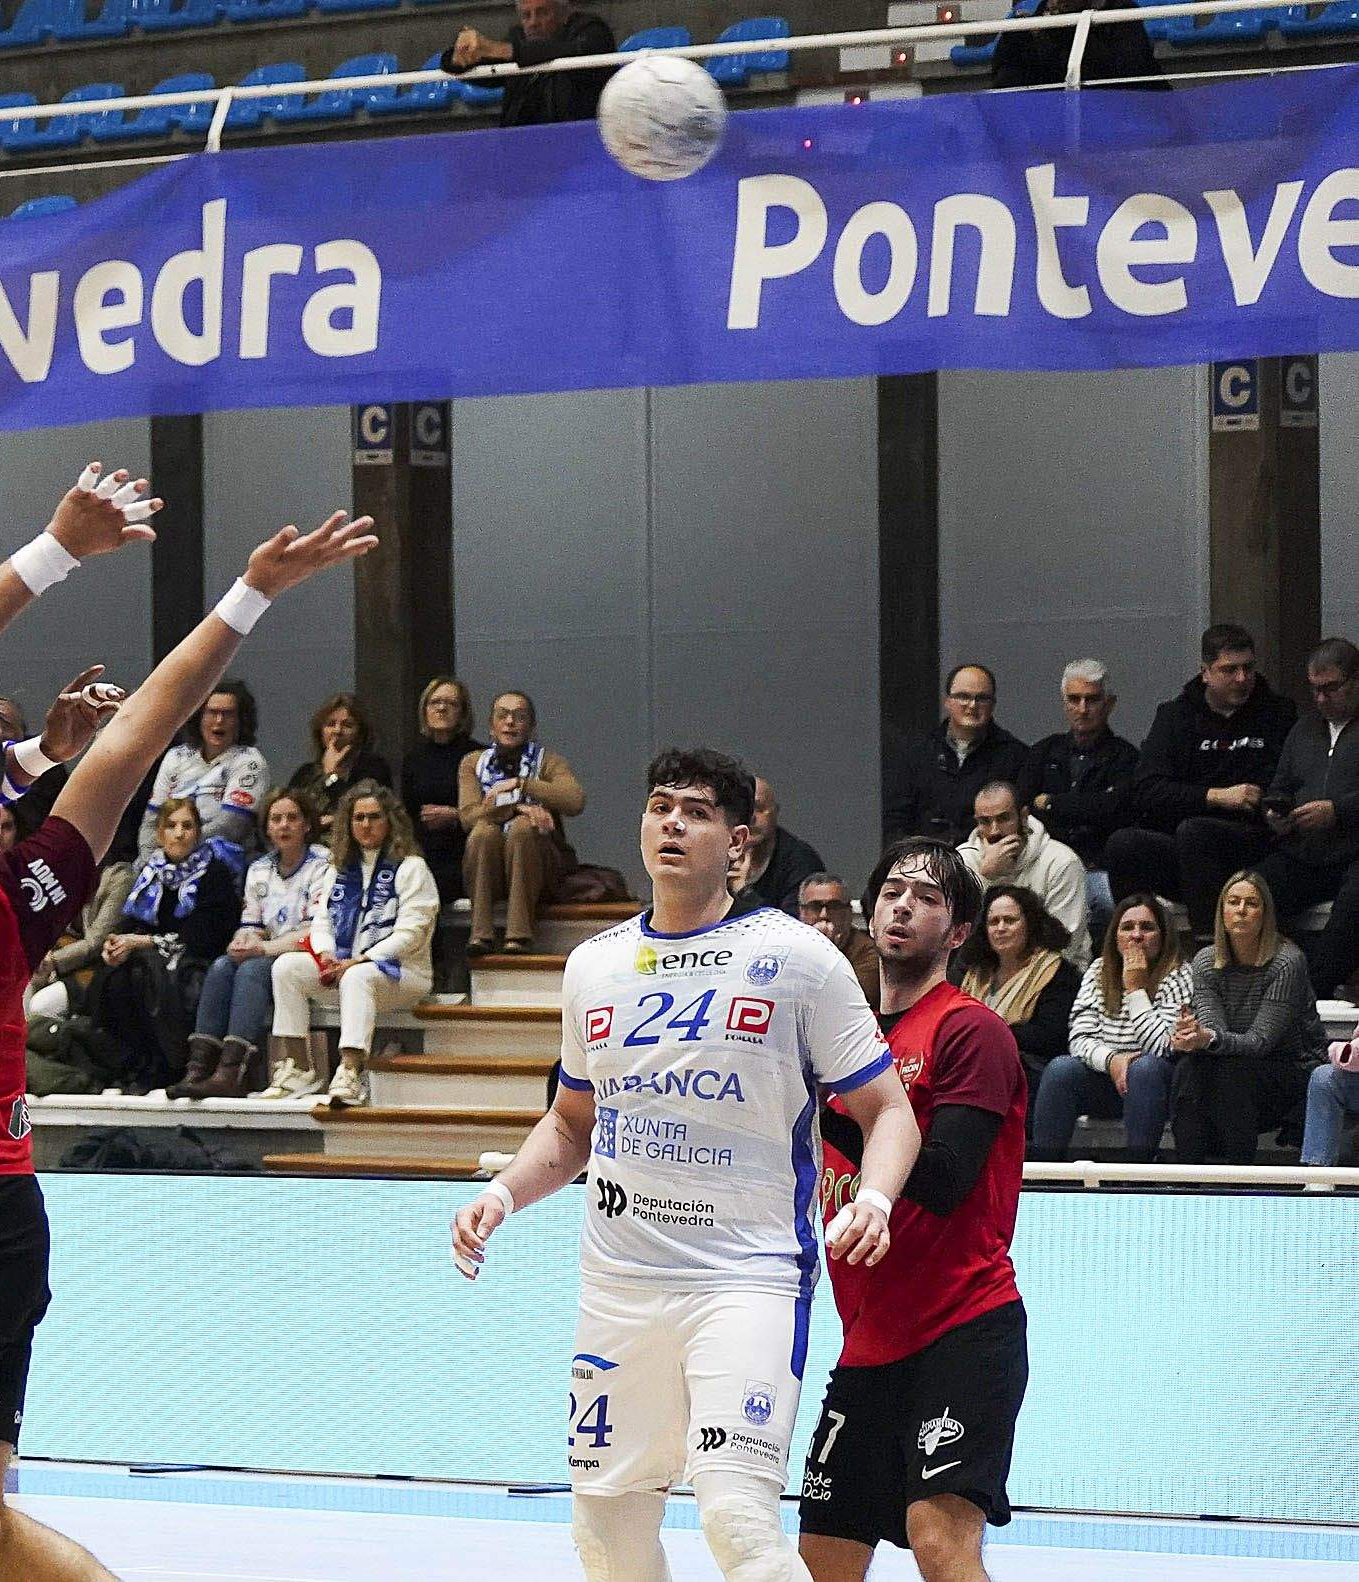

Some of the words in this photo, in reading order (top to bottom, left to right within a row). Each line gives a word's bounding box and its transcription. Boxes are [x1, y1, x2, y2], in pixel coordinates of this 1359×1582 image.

[1220, 365, 1251, 407] C
[1285, 361, 1313, 403] C
[361, 405, 387, 443] C
[416, 405, 442, 443] C
[662, 950, 733, 970] ence
[623, 989, 717, 1047] 24
[622, 1116, 687, 1141] XUNTA
[621, 1137, 641, 1156] DE
[646, 1141, 732, 1166] GALICIA
[632, 1207, 714, 1227] Pontevedra
[633, 1193, 715, 1213] Deputación
[802, 1482, 832, 1501] Ocio
